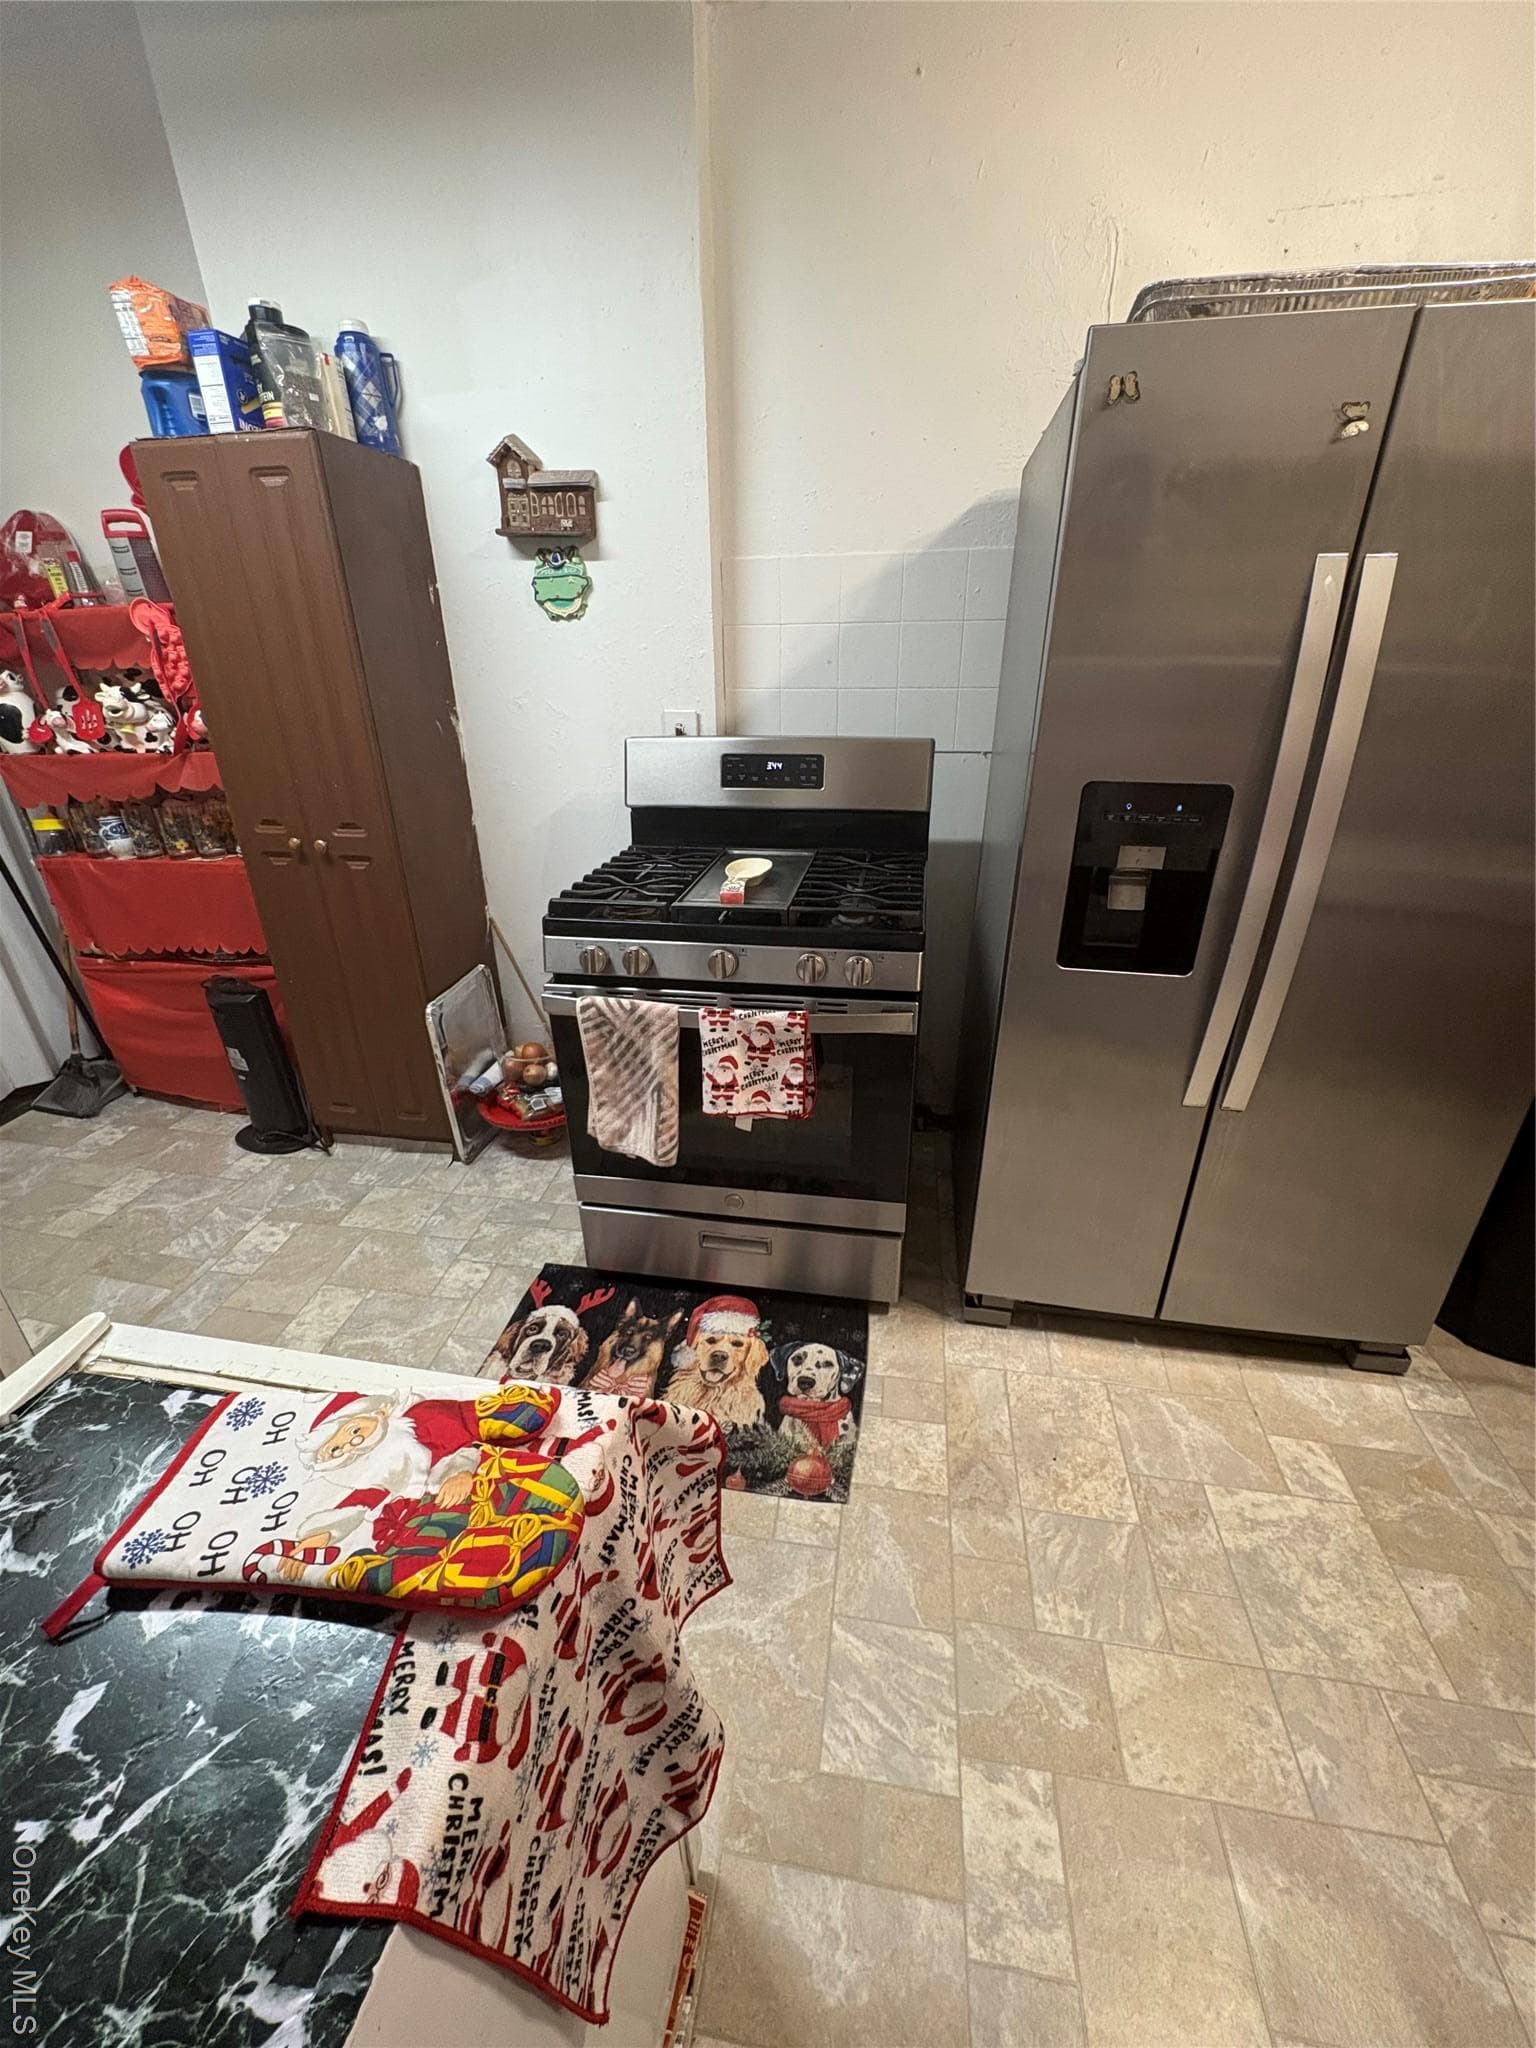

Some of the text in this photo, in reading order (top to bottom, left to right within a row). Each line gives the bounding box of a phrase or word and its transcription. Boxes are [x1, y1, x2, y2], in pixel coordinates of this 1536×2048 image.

[743, 1069, 765, 1082] MERRY
[389, 1640, 416, 1716] MERRY
[664, 1707, 703, 1756] MERRY
[449, 1797, 484, 1904] MERRY
